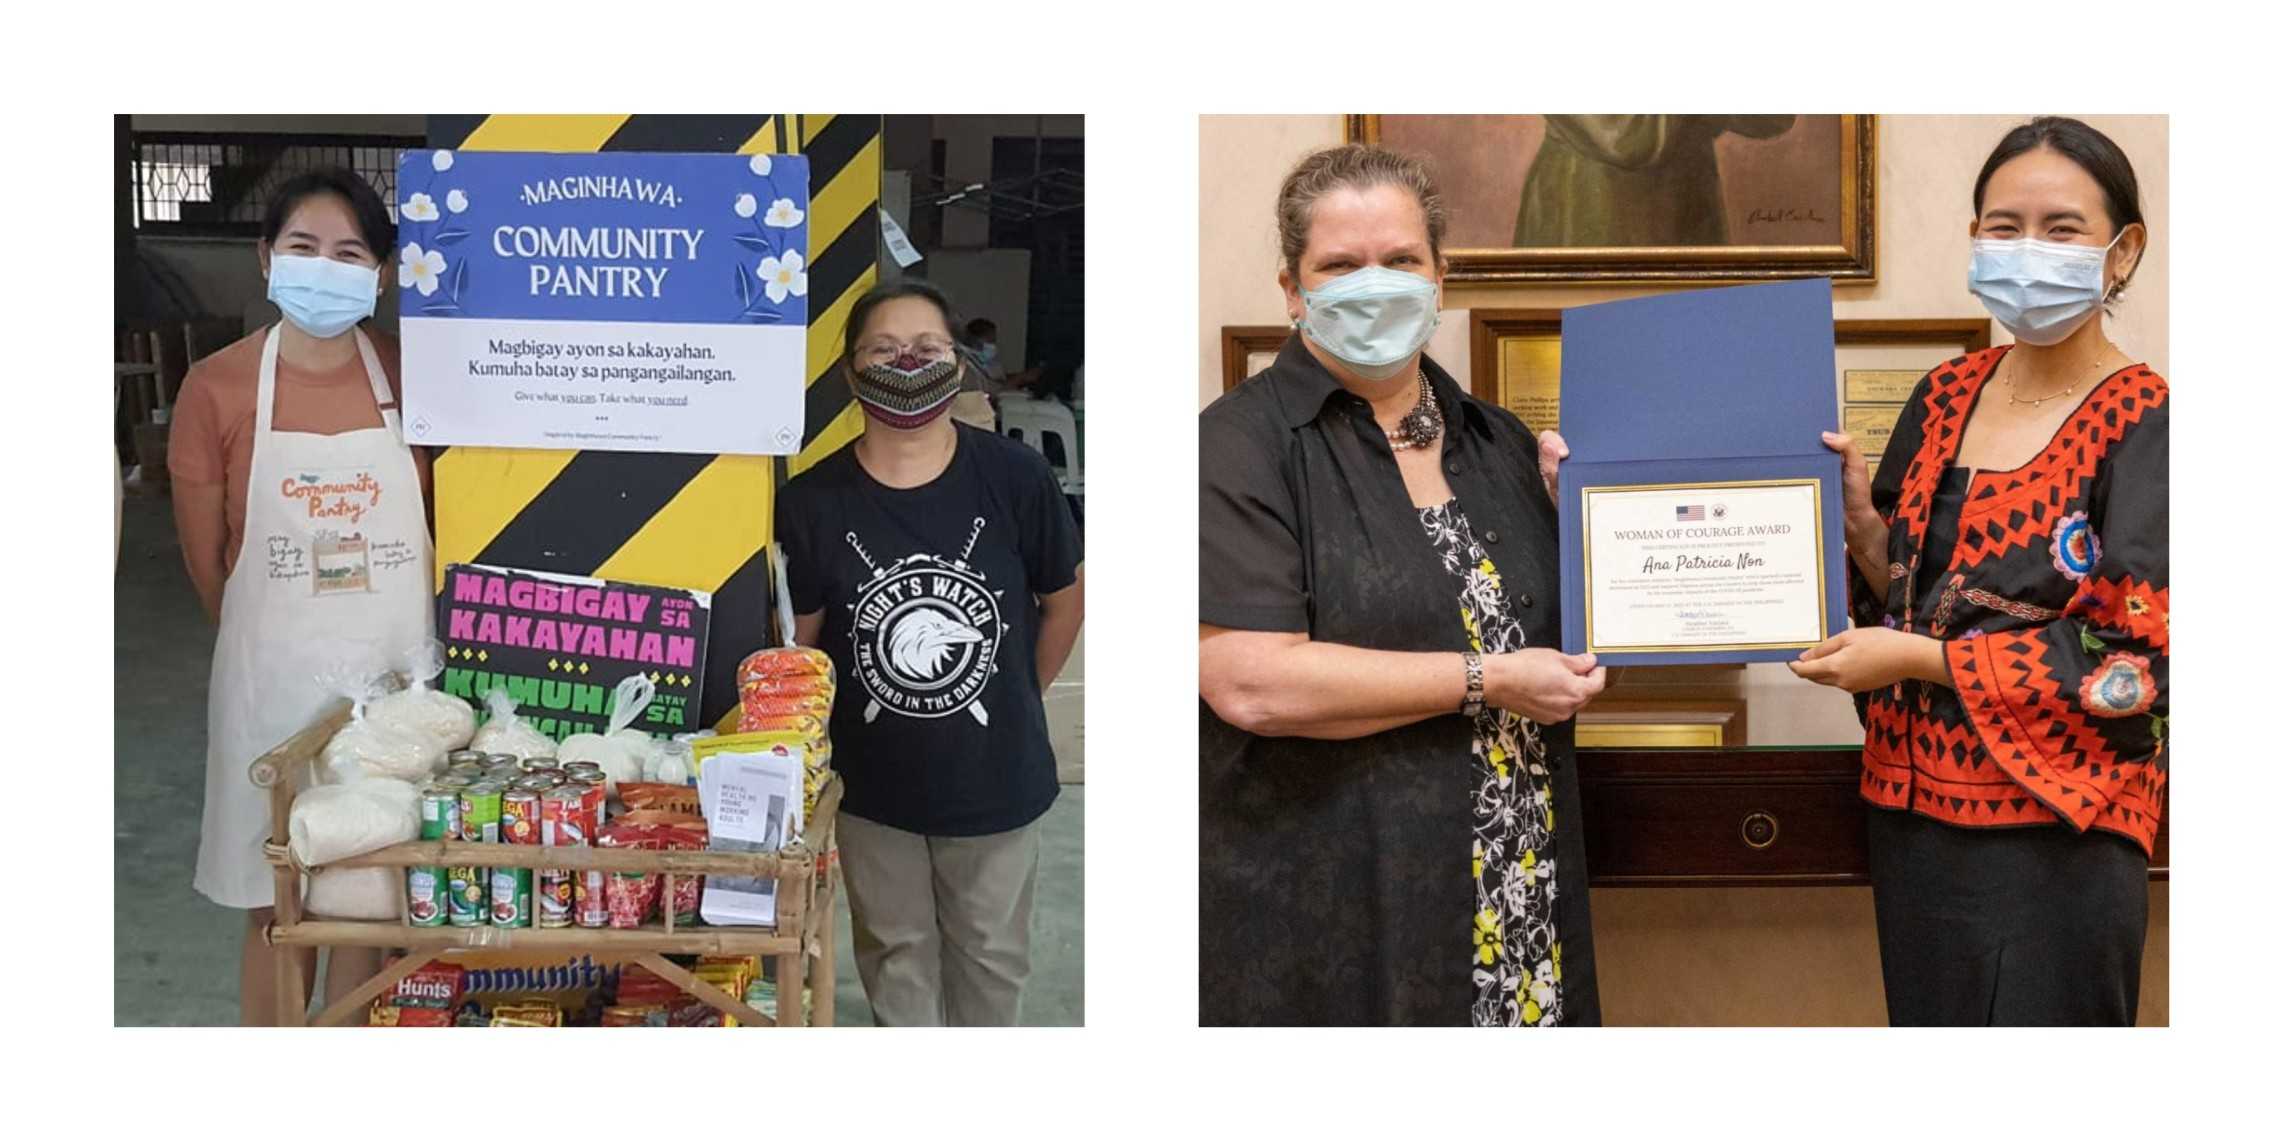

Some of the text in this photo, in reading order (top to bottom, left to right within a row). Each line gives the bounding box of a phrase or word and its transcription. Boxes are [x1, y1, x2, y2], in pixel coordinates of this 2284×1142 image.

[493, 225, 704, 260] COMMUNITY
[529, 264, 668, 298] PANTRY
[488, 338, 716, 362] Magbigay ayon sa kakayahan.
[468, 360, 736, 384] Kumuha batay sa pangangailangan.
[281, 473, 382, 506] Community
[308, 497, 366, 524] Pantry
[1614, 524, 1791, 541] WOMAN OF COURAGE AWARD
[1642, 552, 1765, 575] Ana Patricia Non
[455, 573, 693, 623] MAGBIGAY AYON
[858, 575, 993, 632] NIGHT'S WATCH
[660, 609, 691, 629] SA
[449, 608, 695, 668] KAKAYAHAN
[859, 638, 993, 710] THE SWORD IN THE DARKNESS
[645, 704, 684, 725] SA
